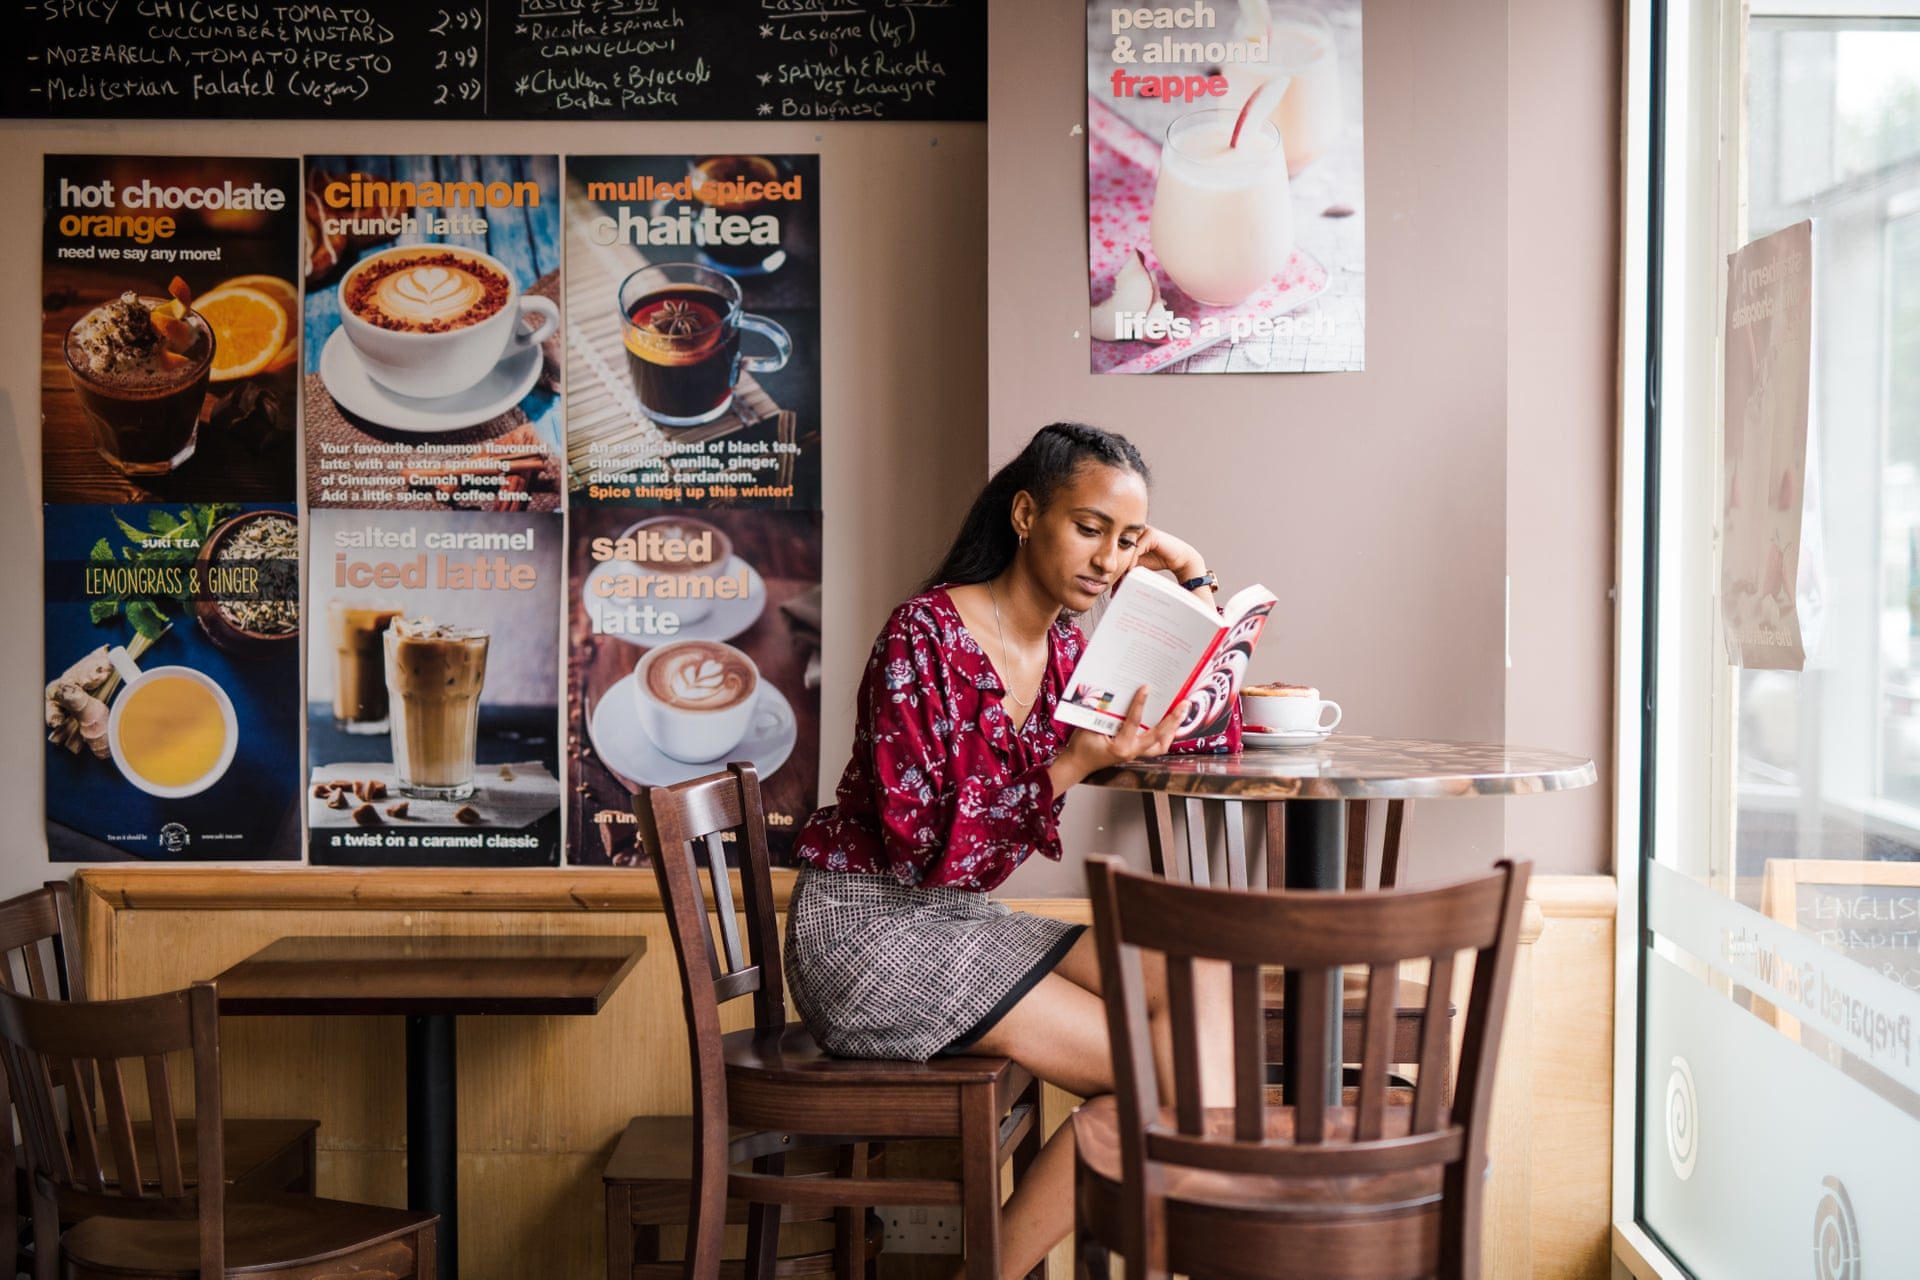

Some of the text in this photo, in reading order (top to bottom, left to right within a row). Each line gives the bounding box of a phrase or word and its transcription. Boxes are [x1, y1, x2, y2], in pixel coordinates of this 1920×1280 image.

[273, 4, 375, 26] TOMATO,
[429, 7, 482, 36] 2.99
[1111, 1, 1216, 35] peach
[294, 24, 394, 44] MUSTARD
[532, 19, 594, 40] Ricotta
[780, 26, 862, 56] Lasagne
[435, 46, 478, 69] 2.99
[541, 38, 675, 58] CANNELLONI
[1111, 36, 1270, 64] & almond
[193, 68, 275, 100] Falafel
[532, 68, 607, 94] Chicken
[628, 57, 711, 88] Broccoli
[1111, 68, 1229, 103] frappe
[434, 78, 481, 104] 2.99
[556, 88, 678, 109] Bake Pasta
[60, 178, 285, 211] hot chocolate
[324, 173, 540, 208] cinnamon
[588, 175, 801, 205] mulled spiced
[59, 214, 176, 244] orange
[325, 213, 488, 236] crunch latte
[589, 206, 780, 246] chai tea
[58, 246, 221, 262] need we say any more!
[1115, 310, 1337, 344] life's a peach
[320, 442, 547, 454] Your favourite cinnamon flavoured
[589, 442, 614, 453] An
[663, 441, 703, 454] blend
[708, 441, 724, 454] of
[728, 441, 769, 454] black
[773, 442, 801, 456] tea,
[320, 458, 511, 472] latte with an extra sprinkling
[589, 456, 780, 472] cinnamon, vanilla, ginger,
[321, 474, 509, 487] of Cinnamon Crunch Pieces.
[589, 471, 757, 484] cloves and cardamom.
[321, 489, 532, 504] Add a little spice to coffee time.
[589, 485, 794, 500] Spice things up this winter!
[142, 538, 200, 549] SUKI TEA
[335, 527, 535, 550] salted caramel
[592, 530, 712, 562] salted
[85, 566, 259, 595] LEMONGRASS & GINGER
[335, 553, 538, 591] iced latte
[592, 569, 749, 599] caramel
[592, 604, 680, 635] latte
[594, 813, 613, 823] an
[768, 812, 793, 826] the
[331, 833, 539, 848] a twist on a caramel classic
